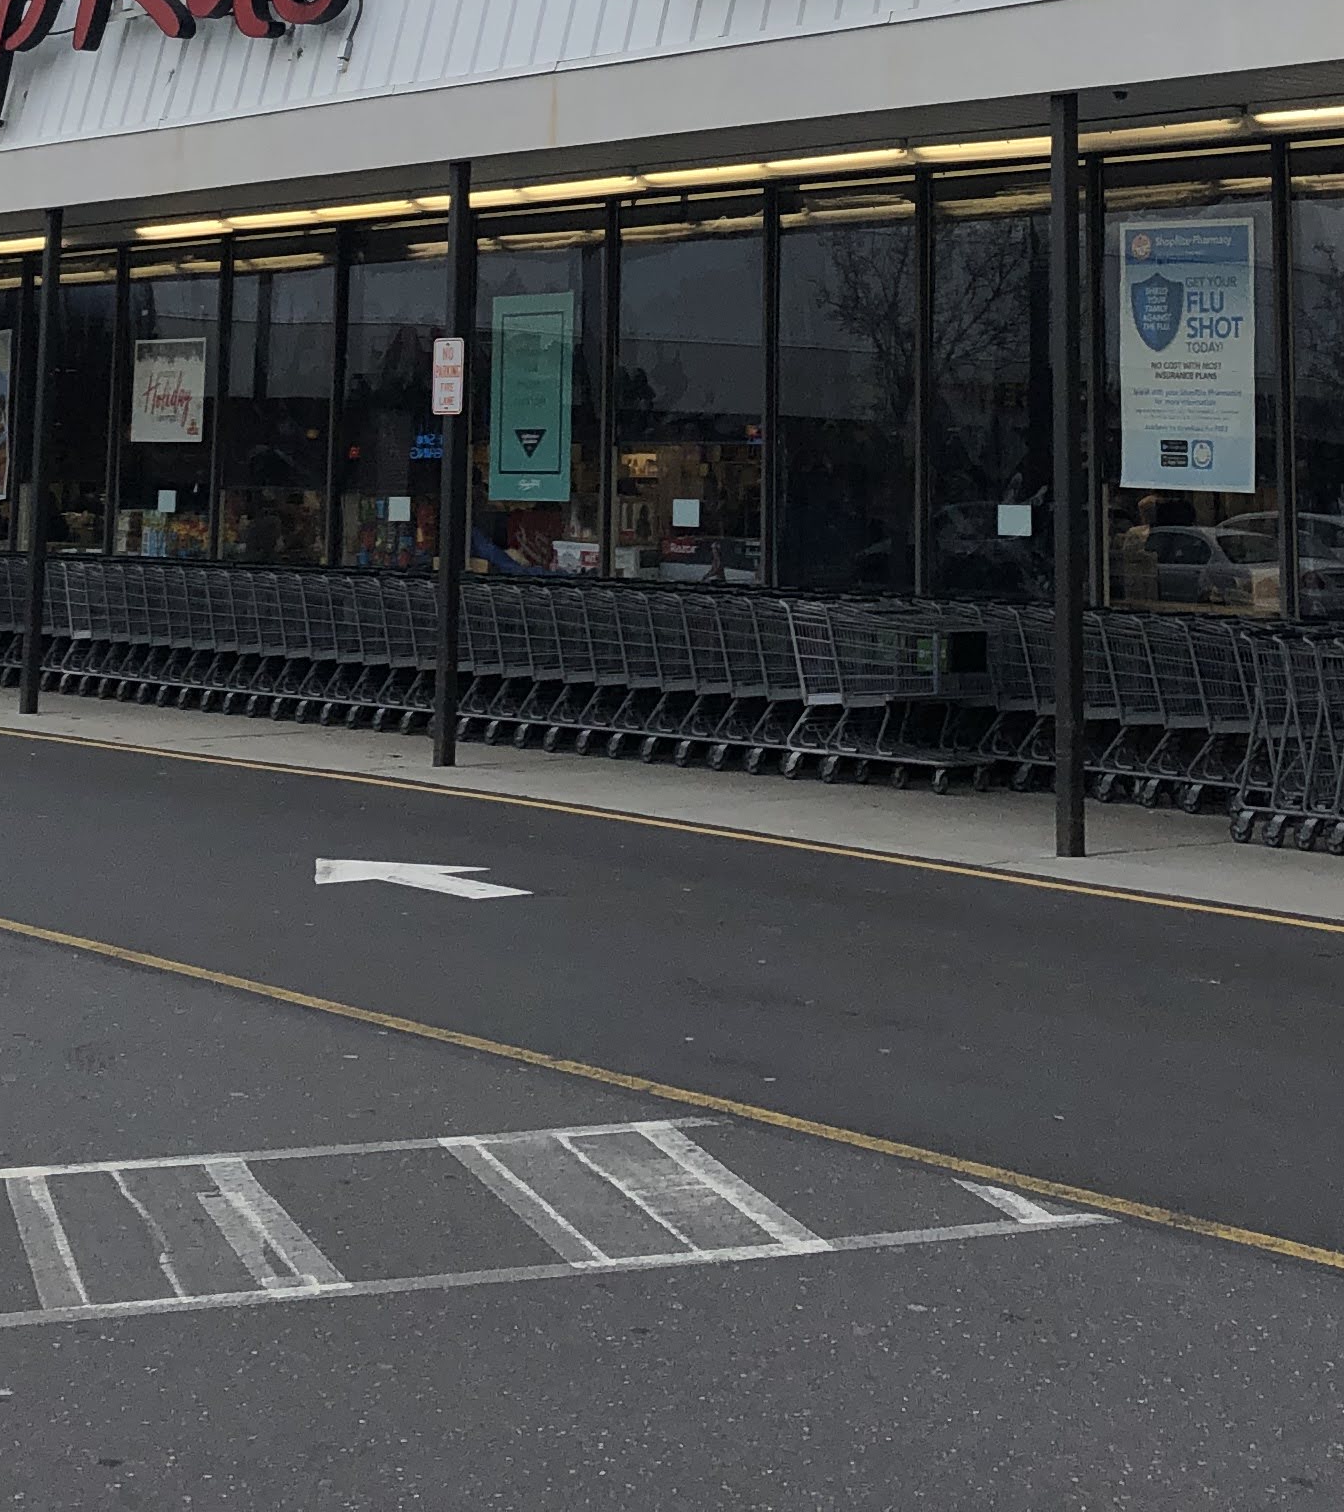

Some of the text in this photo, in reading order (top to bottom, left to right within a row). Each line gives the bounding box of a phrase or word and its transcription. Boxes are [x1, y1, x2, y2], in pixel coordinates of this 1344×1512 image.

[1185, 275, 1237, 287] GET YOUR
[1186, 291, 1224, 313] FLU
[1186, 316, 1243, 338] SHOT
[442, 347, 454, 360] NO
